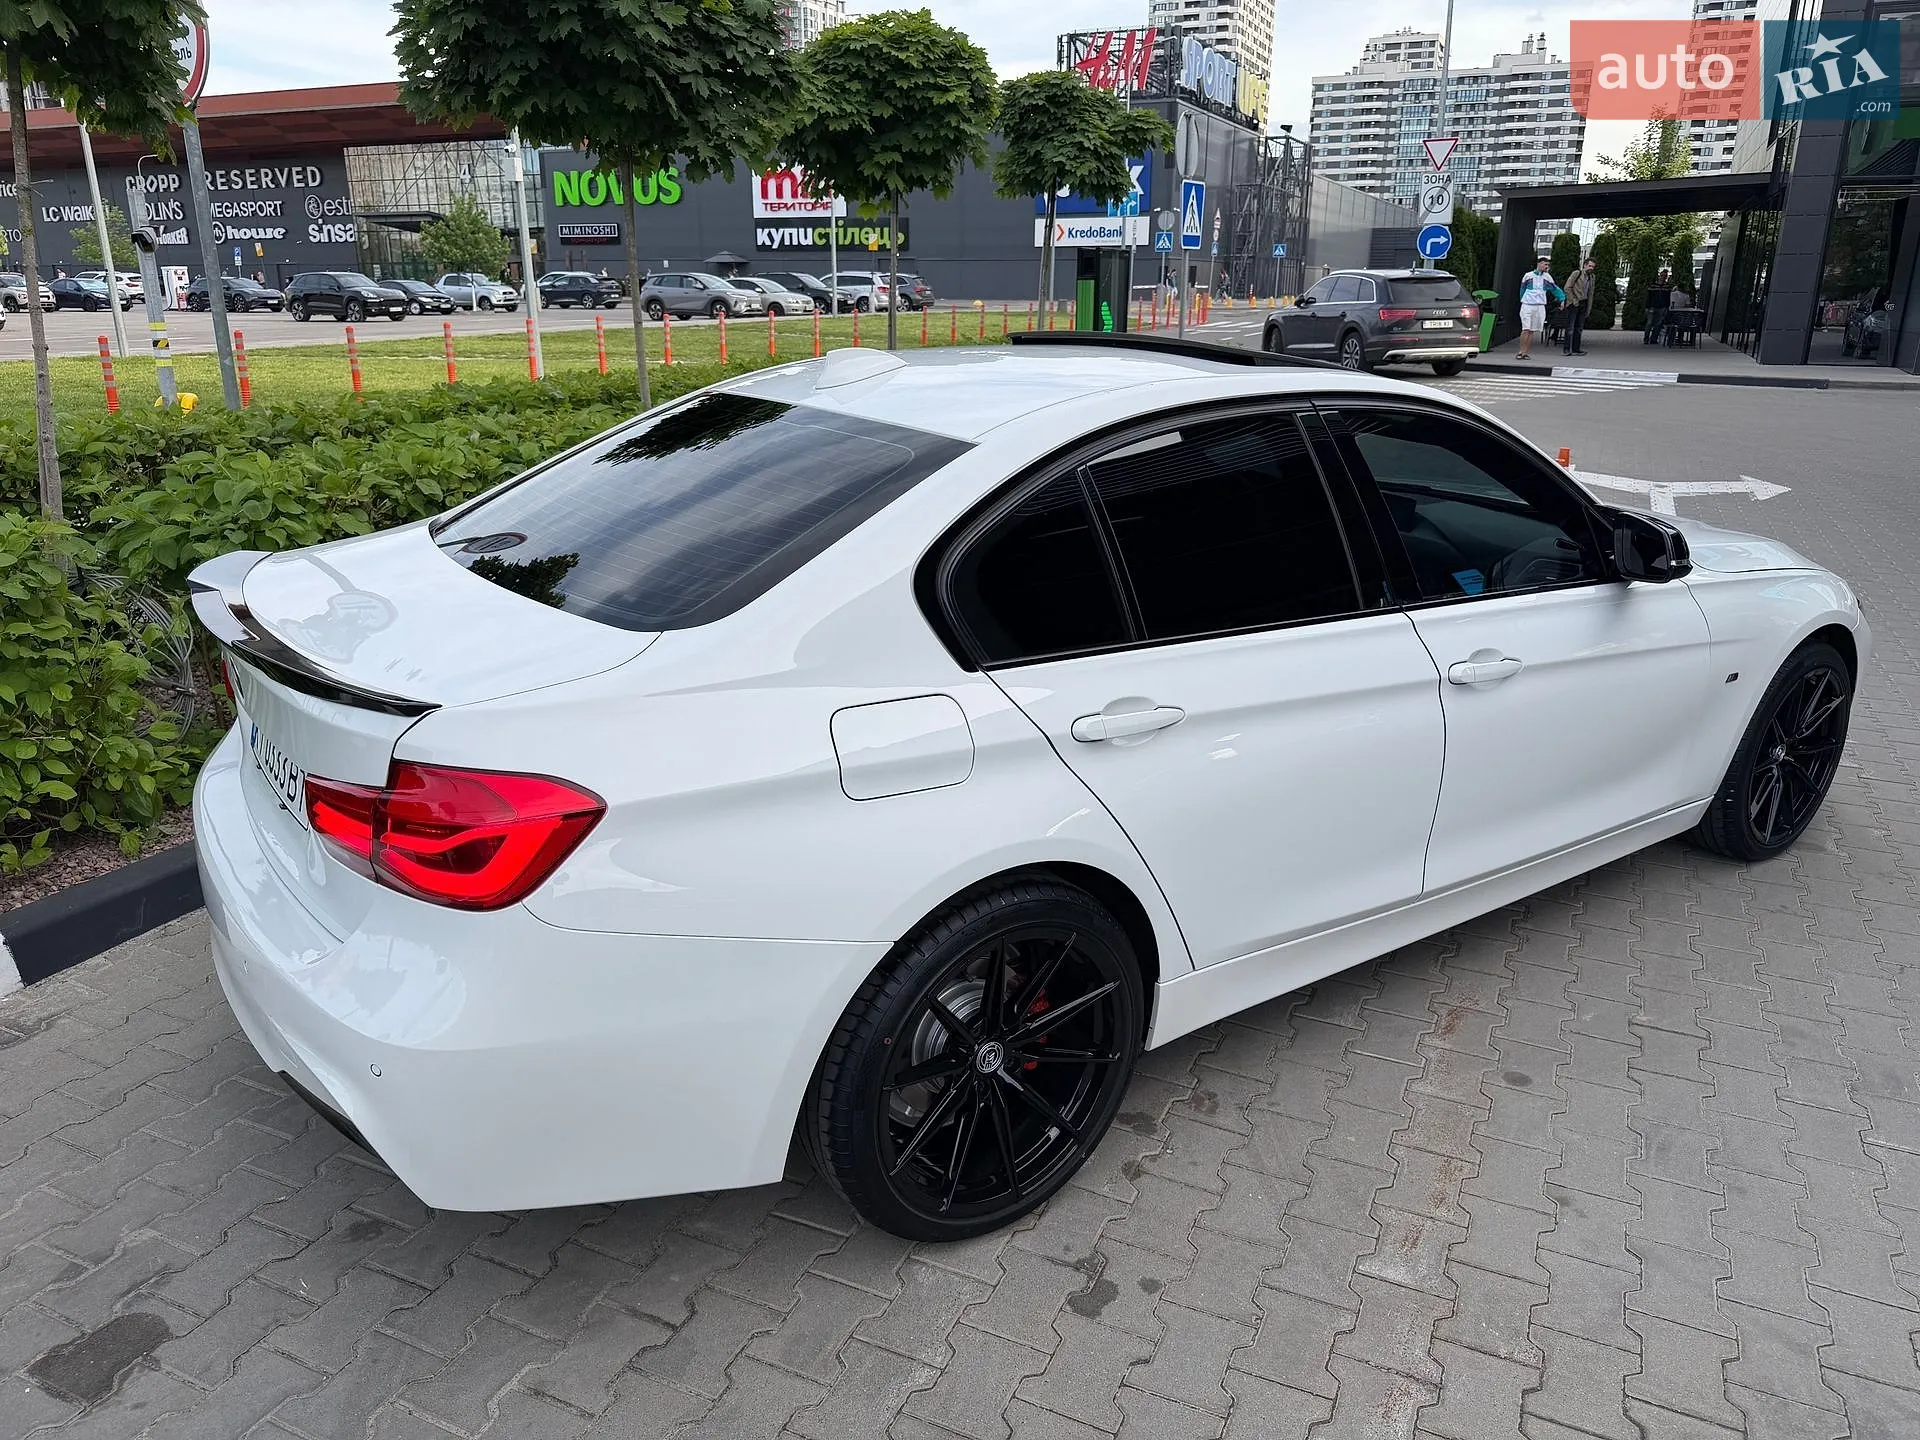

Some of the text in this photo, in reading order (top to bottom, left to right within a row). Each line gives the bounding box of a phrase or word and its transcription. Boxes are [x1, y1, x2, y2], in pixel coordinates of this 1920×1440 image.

[1181, 37, 1237, 107] SPORT
[125, 174, 180, 193] CROPP
[204, 166, 321, 190] RESERVED
[1424, 174, 1451, 185] ЗОНА
[1428, 194, 1444, 206] 10
[145, 198, 183, 220] OLIN'S
[226, 225, 287, 240] house
[562, 226, 615, 236] MIMINOSHI
